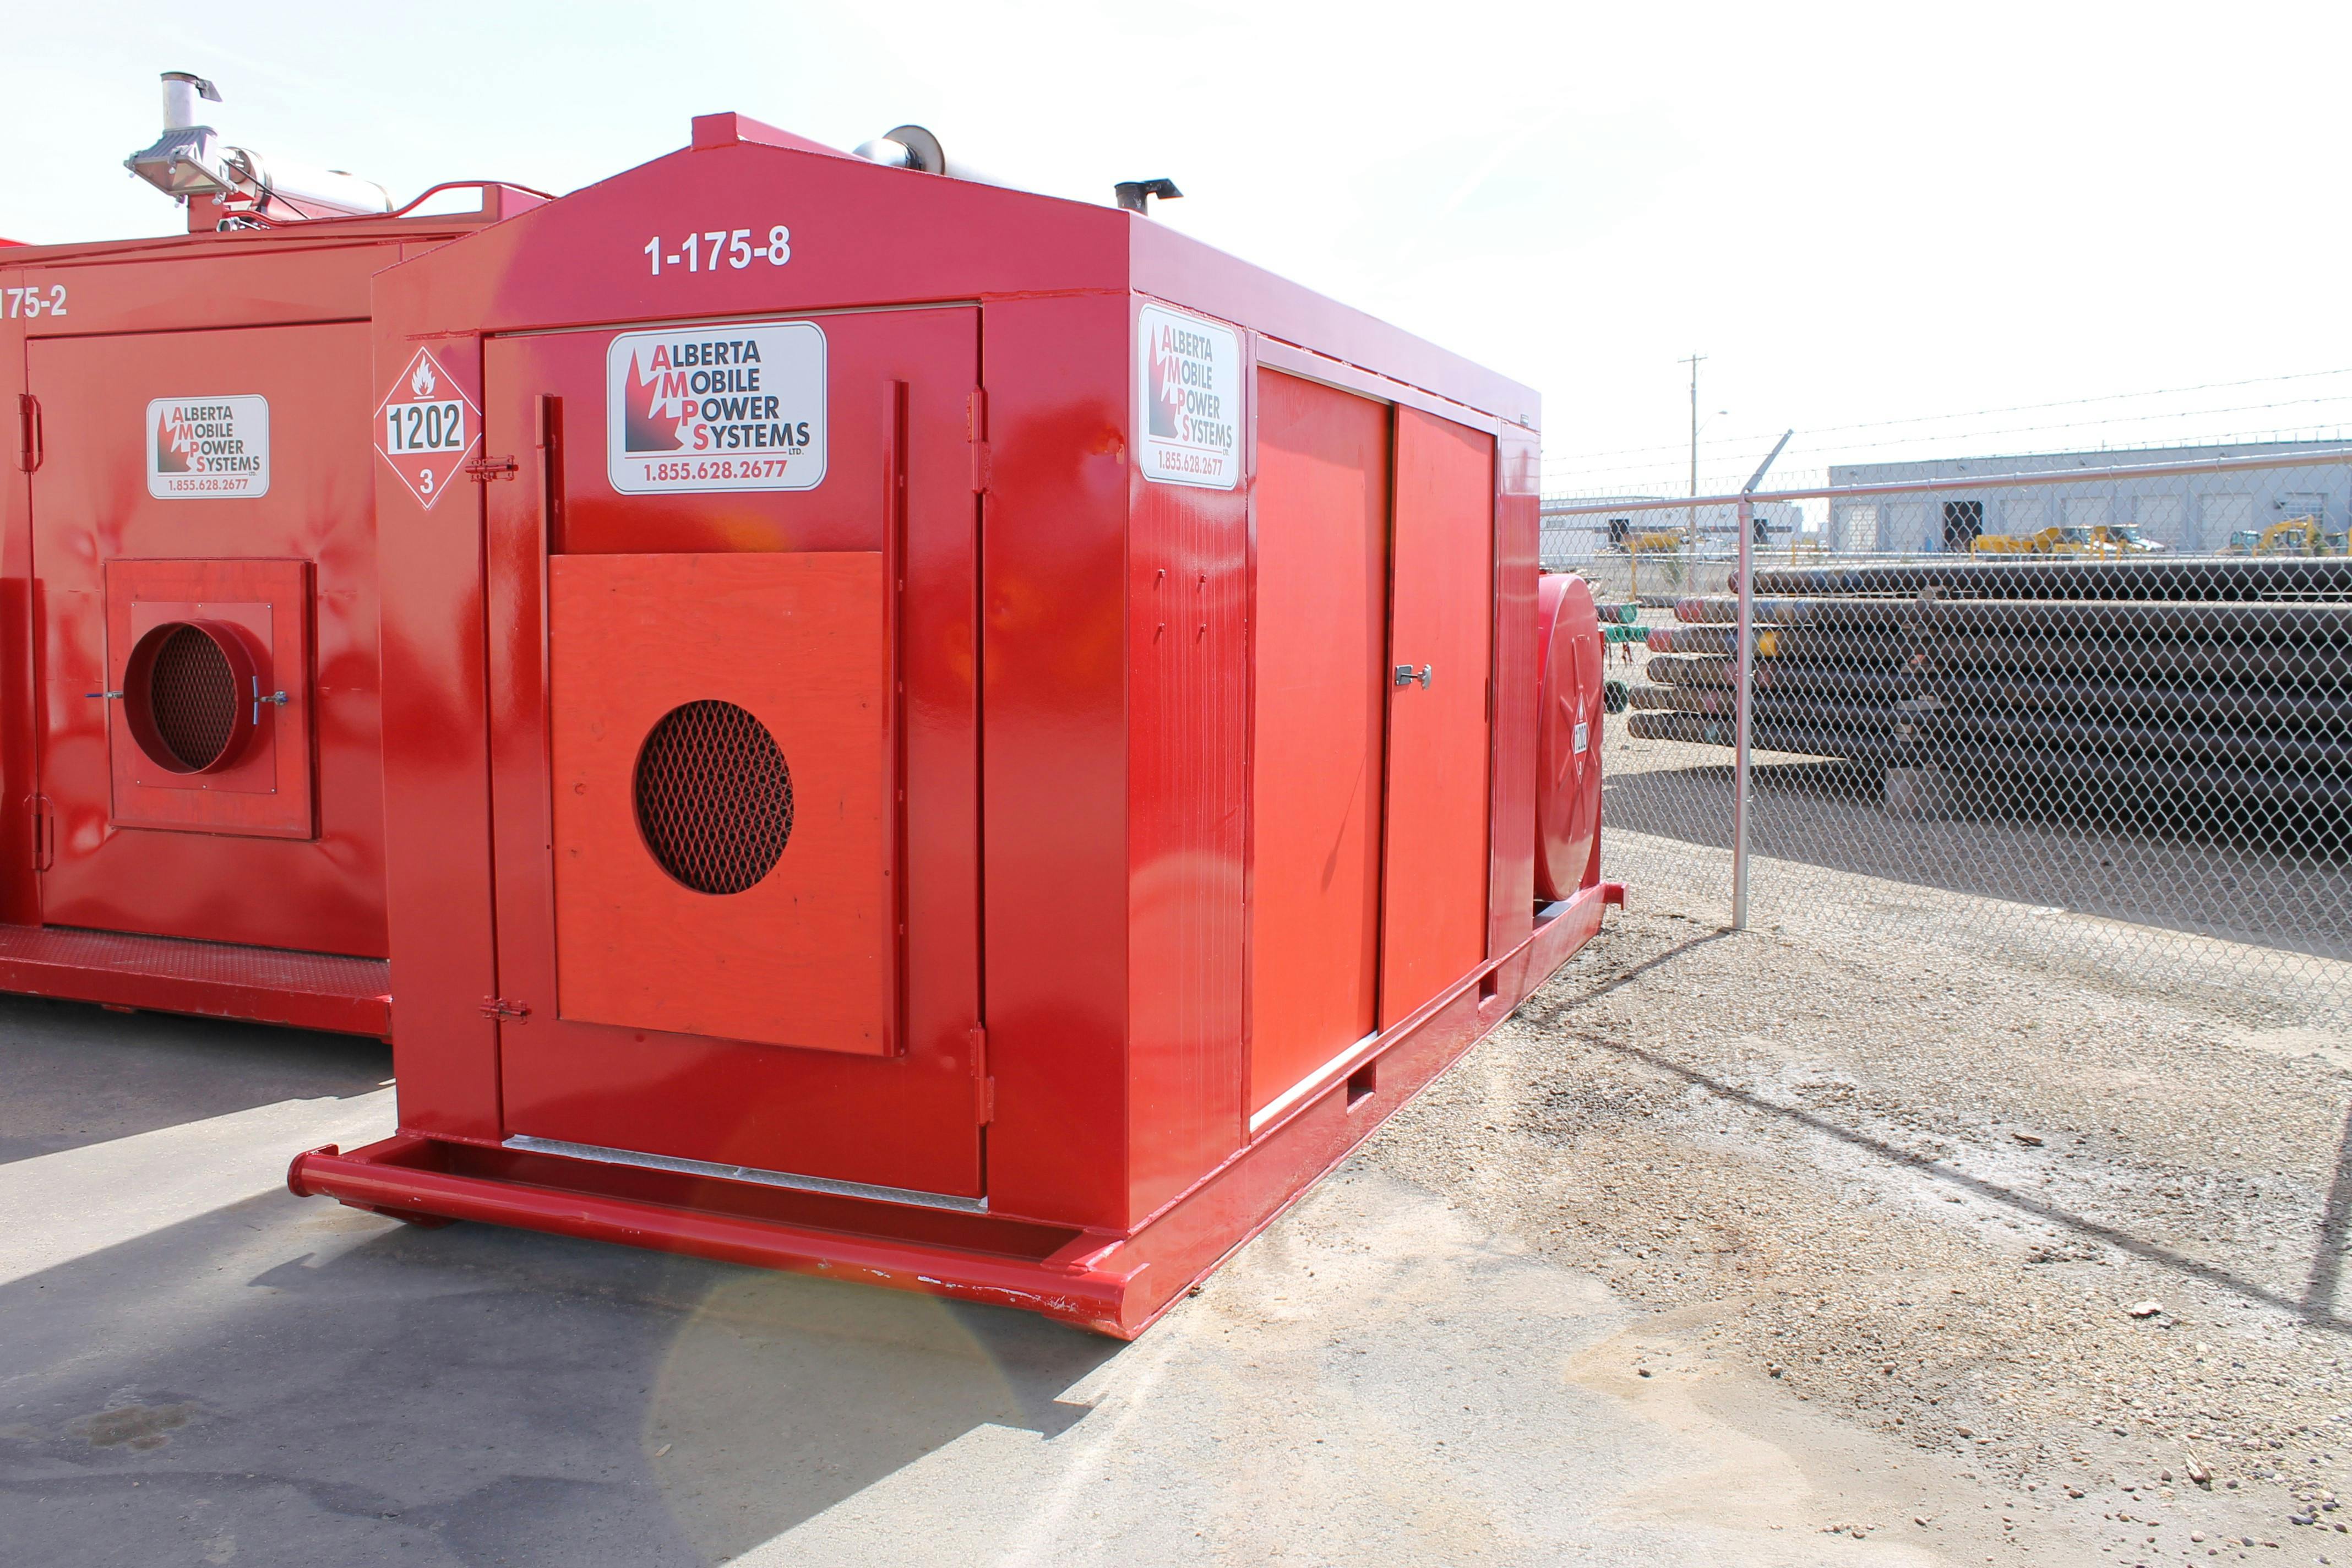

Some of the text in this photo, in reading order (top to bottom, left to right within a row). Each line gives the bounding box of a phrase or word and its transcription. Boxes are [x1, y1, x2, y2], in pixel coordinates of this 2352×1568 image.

[644, 225, 791, 275] 1-175-8
[650, 340, 761, 371] ALBERTA
[1161, 324, 1213, 362] ALBERTA
[661, 368, 760, 398] MOBILE
[1167, 355, 1212, 390] MOBILE
[171, 406, 233, 423] ALBERTA
[682, 396, 780, 426] POWER
[1177, 388, 1220, 419] POWER
[178, 423, 233, 440] MOBILE
[390, 404, 460, 450] 1202
[693, 422, 810, 450] SYSTEMS
[1182, 414, 1232, 449] SYSTEMS
[190, 440, 244, 458] POWER
[1158, 450, 1223, 476] 1.855.628.2677
[196, 456, 260, 472] SYSTEMS
[644, 460, 787, 481] 1.855.628.2677
[168, 478, 248, 491] 1.855.628.2677
[420, 469, 433, 494] 3
